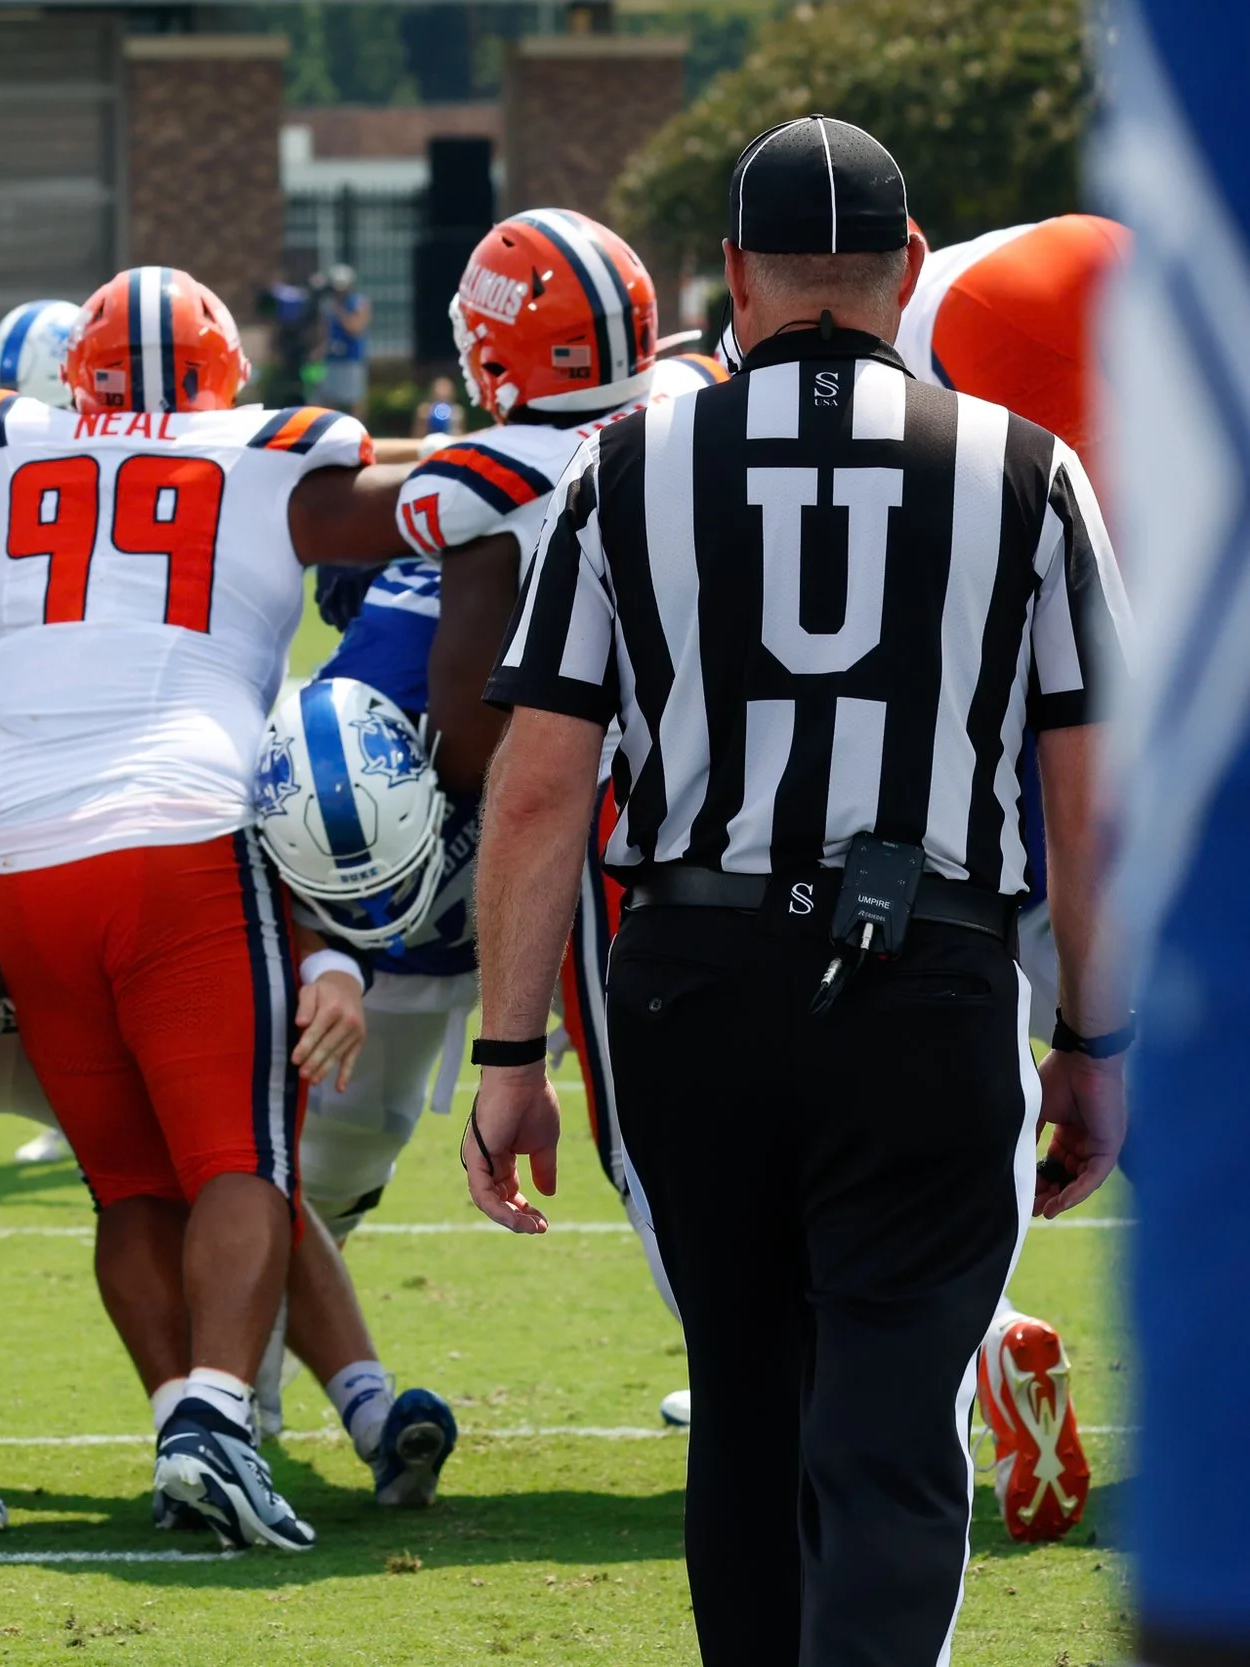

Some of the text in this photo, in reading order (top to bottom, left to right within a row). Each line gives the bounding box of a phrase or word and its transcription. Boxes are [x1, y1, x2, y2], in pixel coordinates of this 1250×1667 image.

[814, 398, 838, 406] USA
[73, 408, 178, 441] NEAL
[6, 453, 225, 634] 99
[747, 467, 904, 674] U
[857, 894, 891, 910] UMPIRE
